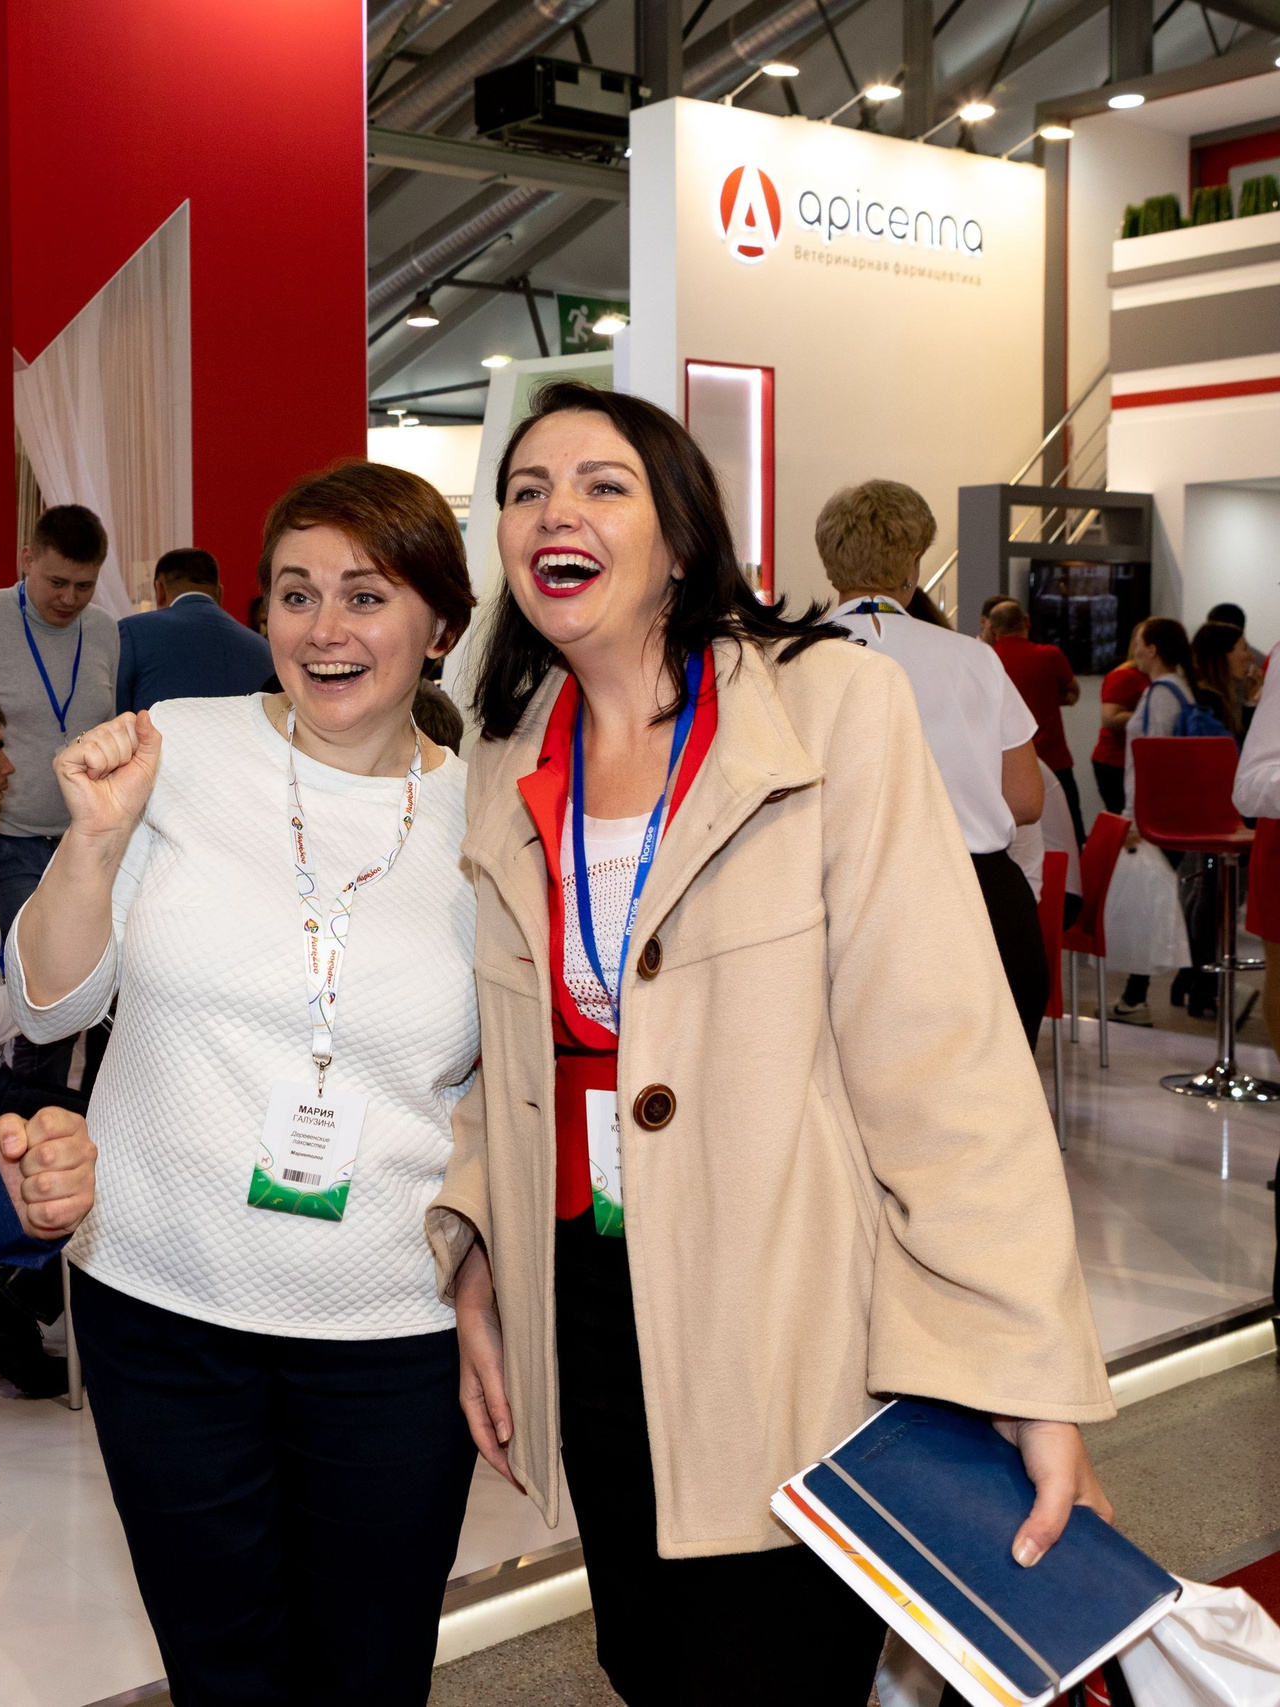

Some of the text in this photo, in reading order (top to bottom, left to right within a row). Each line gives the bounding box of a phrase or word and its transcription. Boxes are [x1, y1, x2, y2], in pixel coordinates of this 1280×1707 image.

[799, 188, 983, 253] apicenna
[794, 245, 982, 287] Ветеринарная фармацевтика
[292, 1114, 336, 1129] ГАЛУЗИНА
[298, 1104, 334, 1119] МАРИЯ
